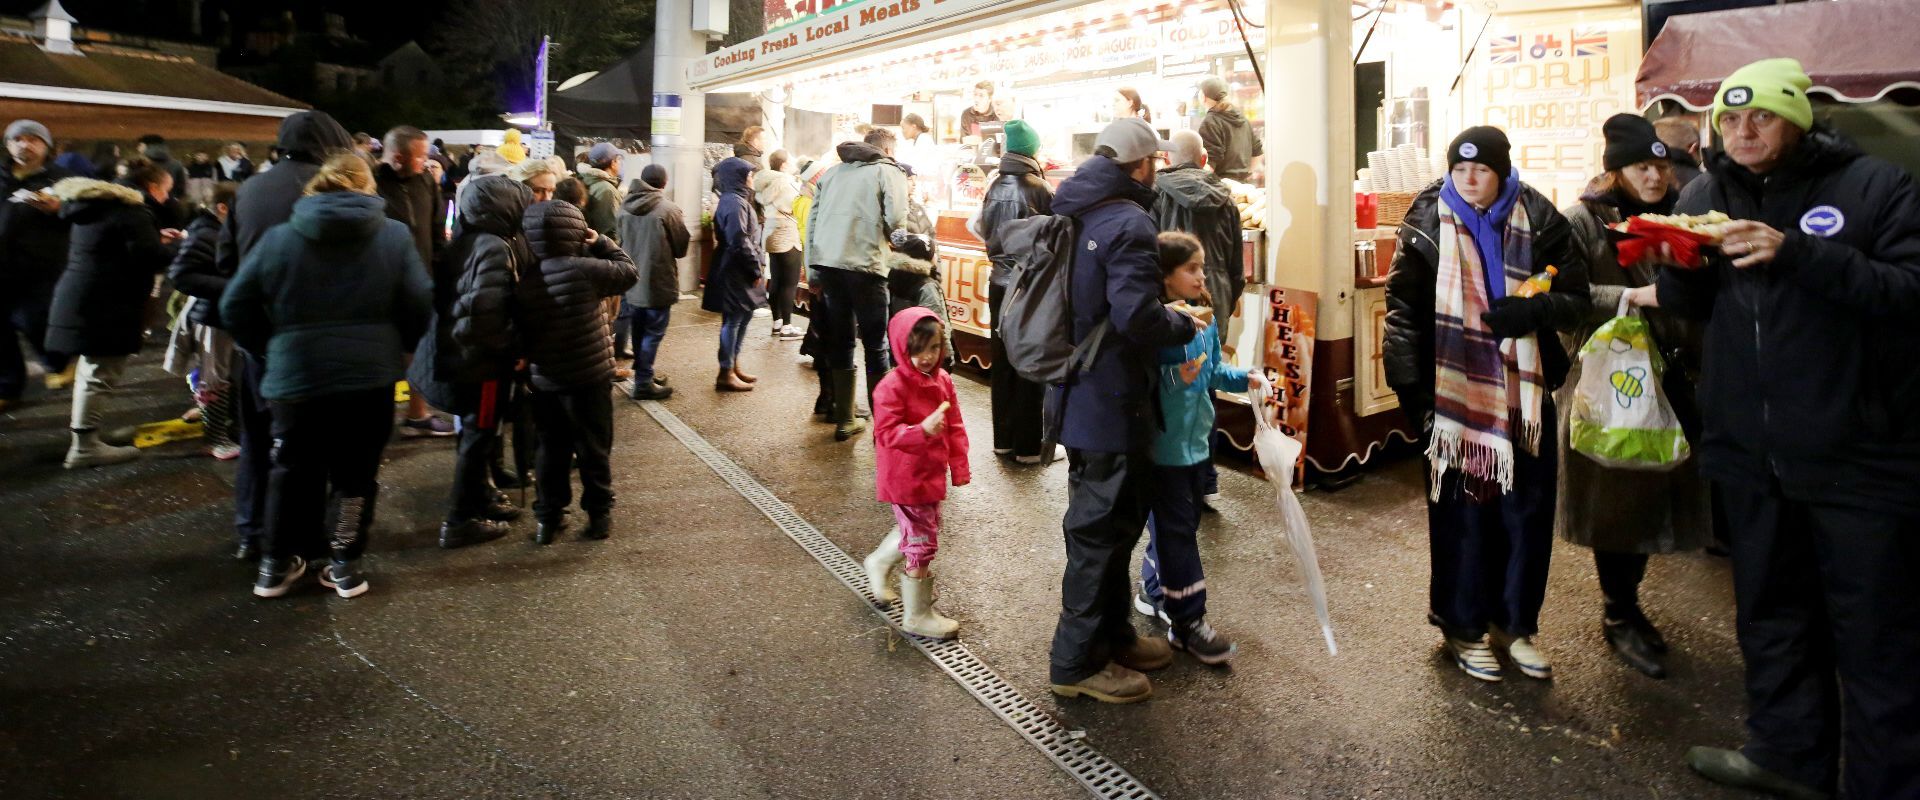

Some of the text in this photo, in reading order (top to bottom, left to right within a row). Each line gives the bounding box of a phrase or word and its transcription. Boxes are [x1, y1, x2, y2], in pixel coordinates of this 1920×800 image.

[714, 46, 755, 69] Cooking
[761, 31, 798, 55] Fresh
[806, 15, 849, 42] Local
[859, 0, 921, 27] Meats
[1169, 24, 1209, 42] COLD
[930, 64, 980, 81] CHIPS
[1483, 57, 1618, 103] PORK
[1270, 288, 1307, 398] CHEESY
[1264, 366, 1297, 437] CHIP
